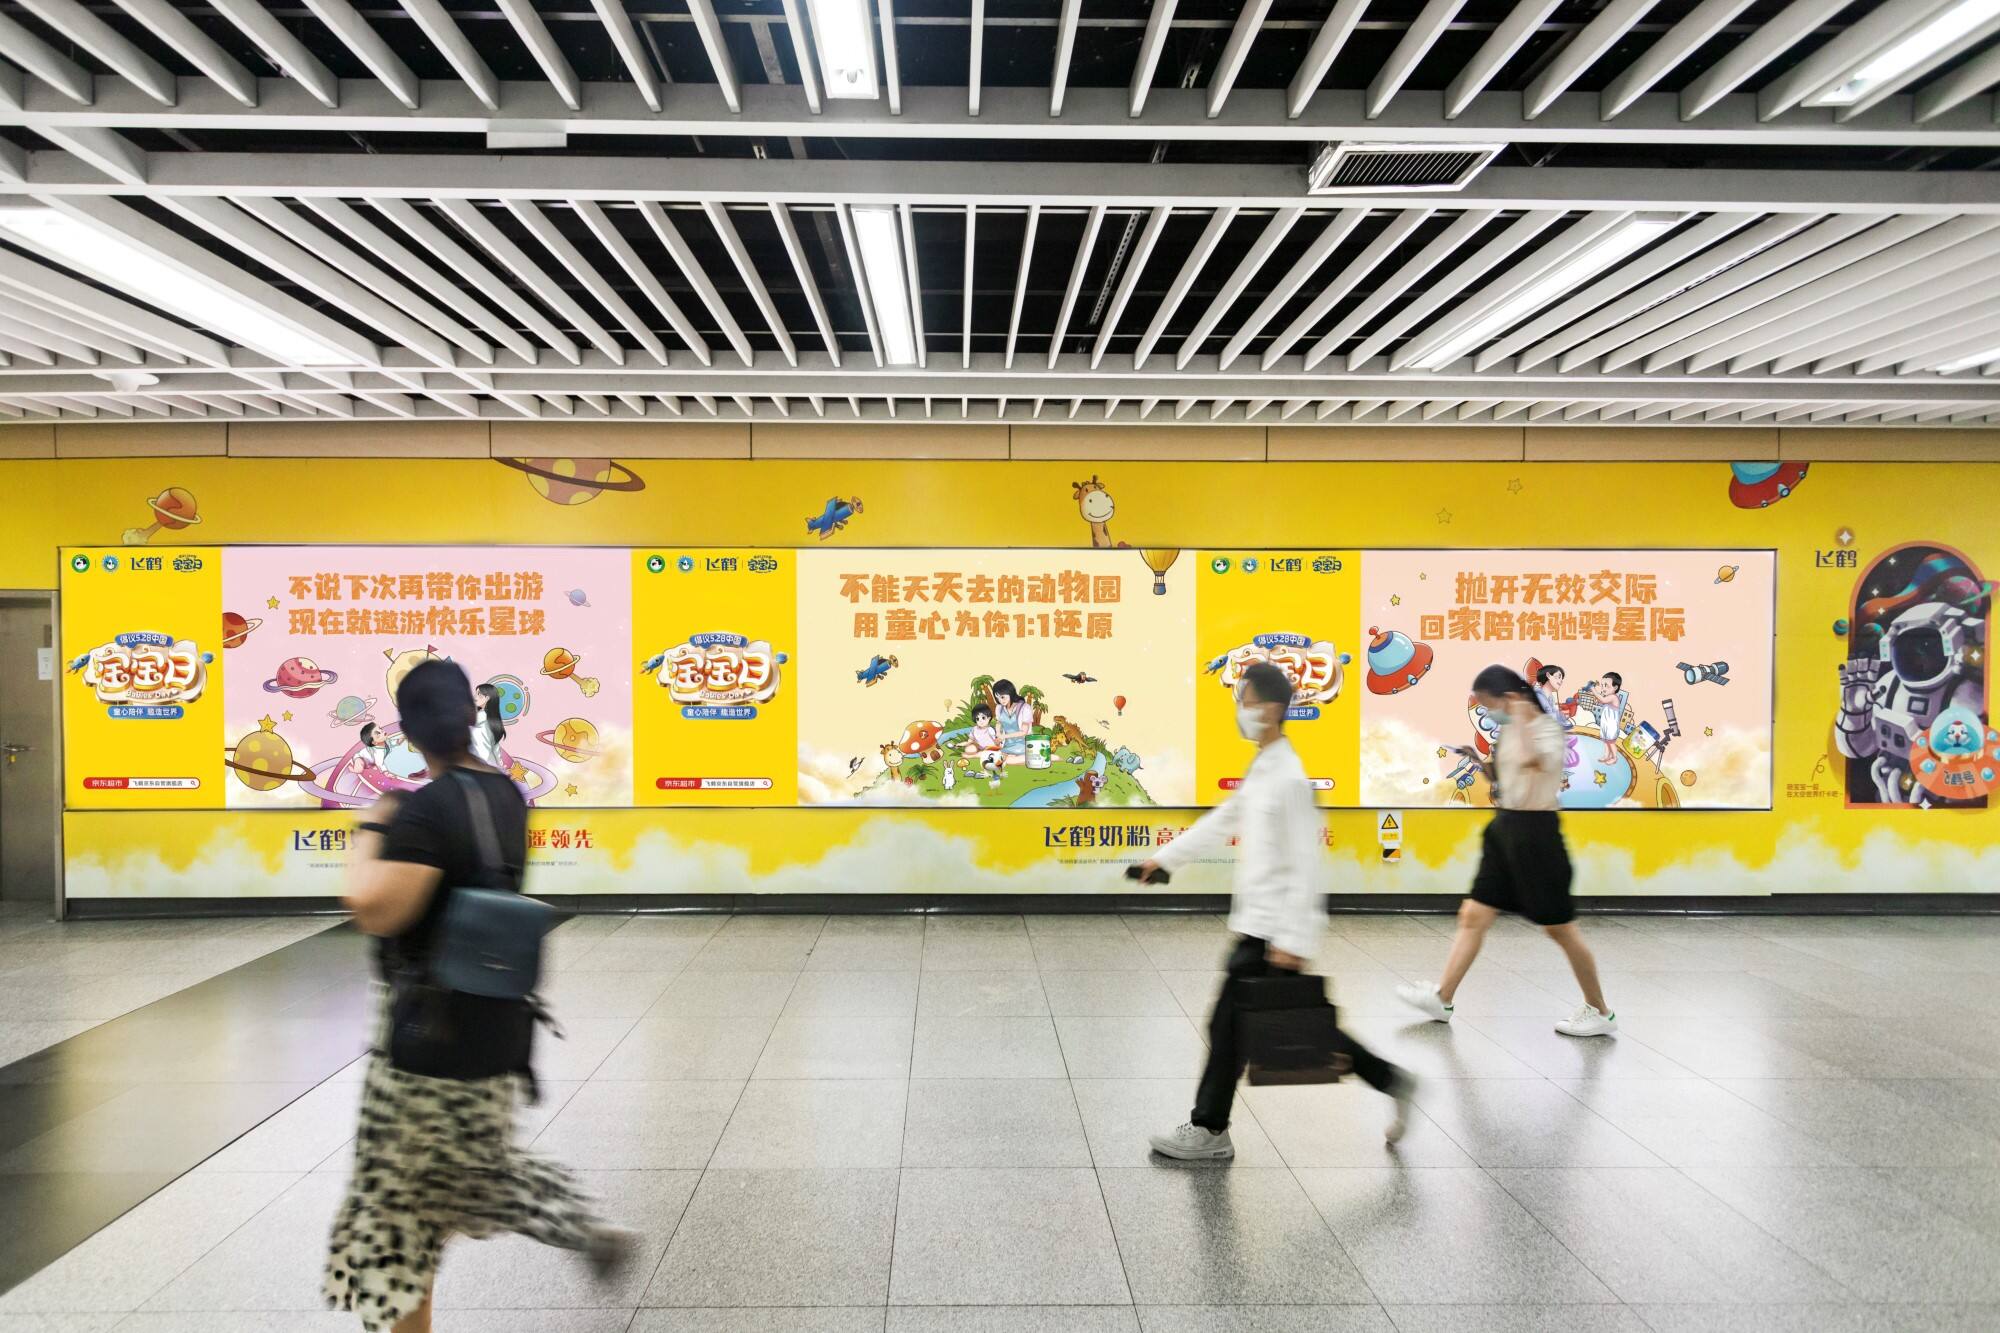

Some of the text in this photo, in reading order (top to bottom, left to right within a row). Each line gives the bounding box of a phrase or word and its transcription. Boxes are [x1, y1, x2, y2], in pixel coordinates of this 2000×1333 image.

[130, 556, 162, 571] 飞鹤
[705, 557, 737, 571] 飞鹤
[1270, 558, 1302, 572] 飞鹤
[1814, 550, 1857, 568] 飞鹤
[288, 571, 544, 601] 不说下次再带你出游
[839, 570, 1121, 604] 不能天天去的动物园
[1455, 569, 1658, 605] 抛开无效交际
[288, 605, 546, 636] 现在就遨游快乐星球
[853, 608, 1113, 641] 用童心为你1:1还原
[1420, 606, 1686, 642] 回家陪你驰骋星际
[92, 647, 197, 692] 宝宝日
[667, 647, 771, 692] 宝宝日
